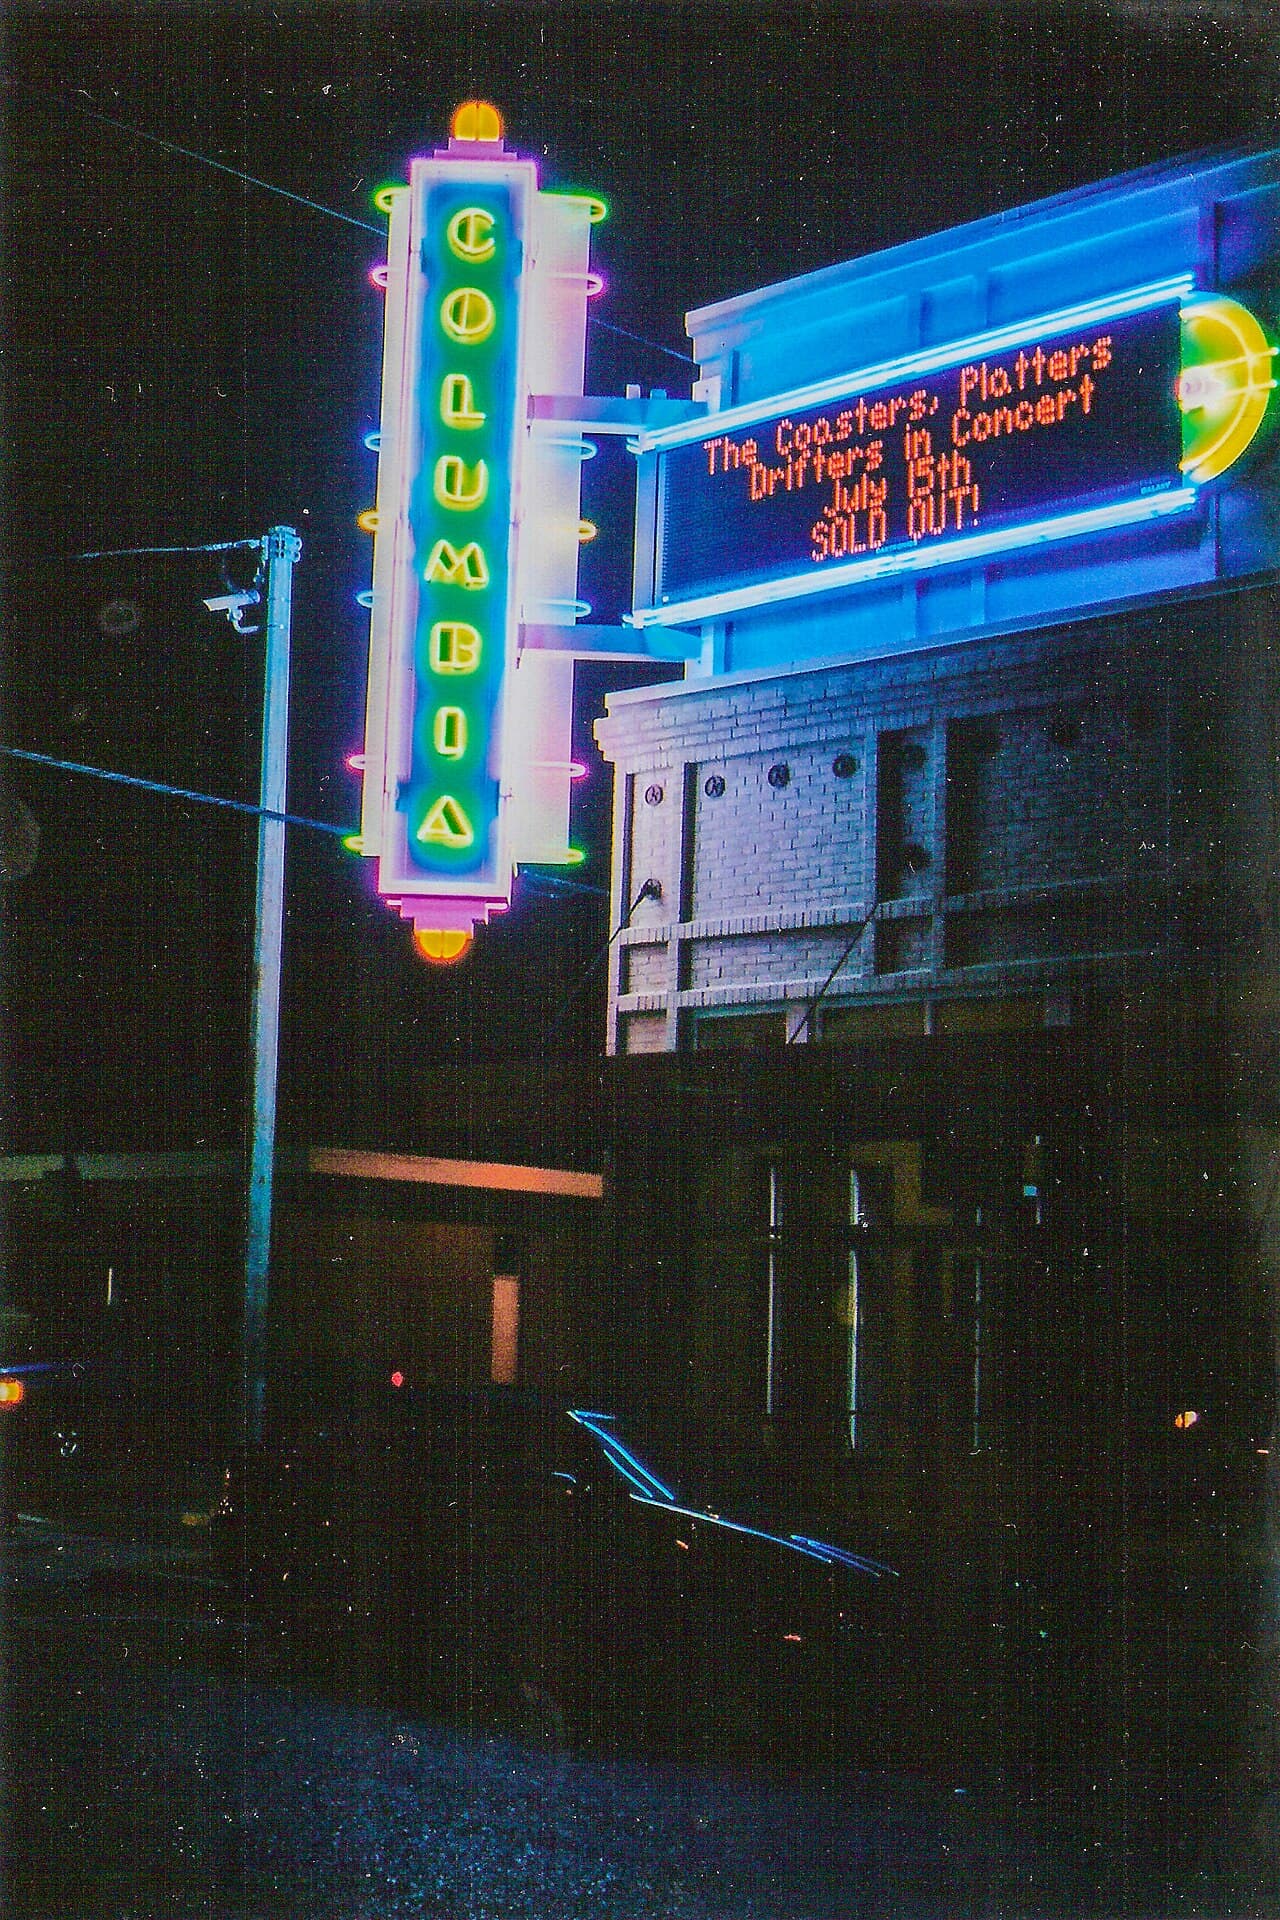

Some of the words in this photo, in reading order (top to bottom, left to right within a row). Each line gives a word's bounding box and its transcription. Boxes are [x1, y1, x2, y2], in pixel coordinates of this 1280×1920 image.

[703, 436, 757, 475] The
[776, 390, 939, 456] Coasters,
[960, 336, 1112, 407] Platters
[750, 440, 883, 501] Drifters
[904, 423, 931, 461] in
[952, 374, 1095, 447] Concert
[416, 205, 498, 848] COLUMBIA
[811, 511, 887, 562] SOLD
[907, 483, 979, 539] OUT!
[823, 473, 887, 518] July
[907, 450, 970, 498] 15th
